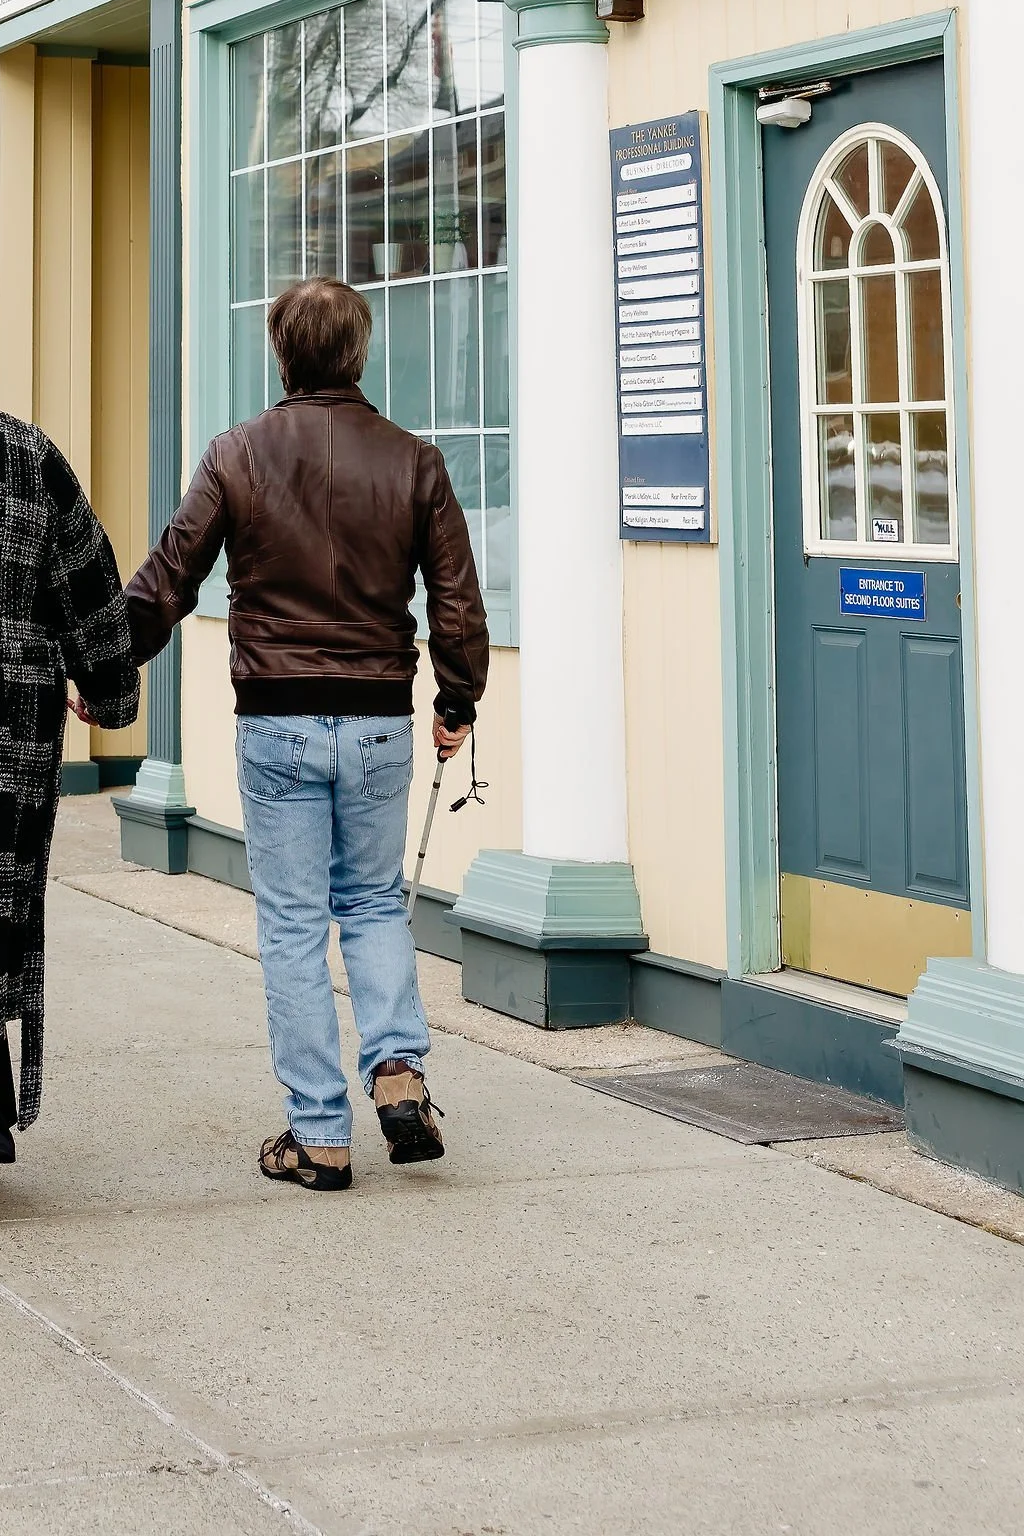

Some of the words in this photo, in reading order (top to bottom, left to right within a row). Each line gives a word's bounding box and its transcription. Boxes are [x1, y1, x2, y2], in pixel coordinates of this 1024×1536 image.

[631, 129, 646, 144] THE
[647, 123, 677, 141] YANKEE
[615, 142, 662, 161] PROFESSIONAL
[663, 135, 695, 152] BUILDING
[626, 165, 654, 176] BUSINESS
[656, 158, 686, 170] DIRECTORY
[859, 578, 893, 592] ENTRANCE
[895, 580, 905, 592] TO
[844, 593, 872, 606] SECOND
[872, 595, 895, 608] FLOOR
[895, 597, 920, 610] SUITES
